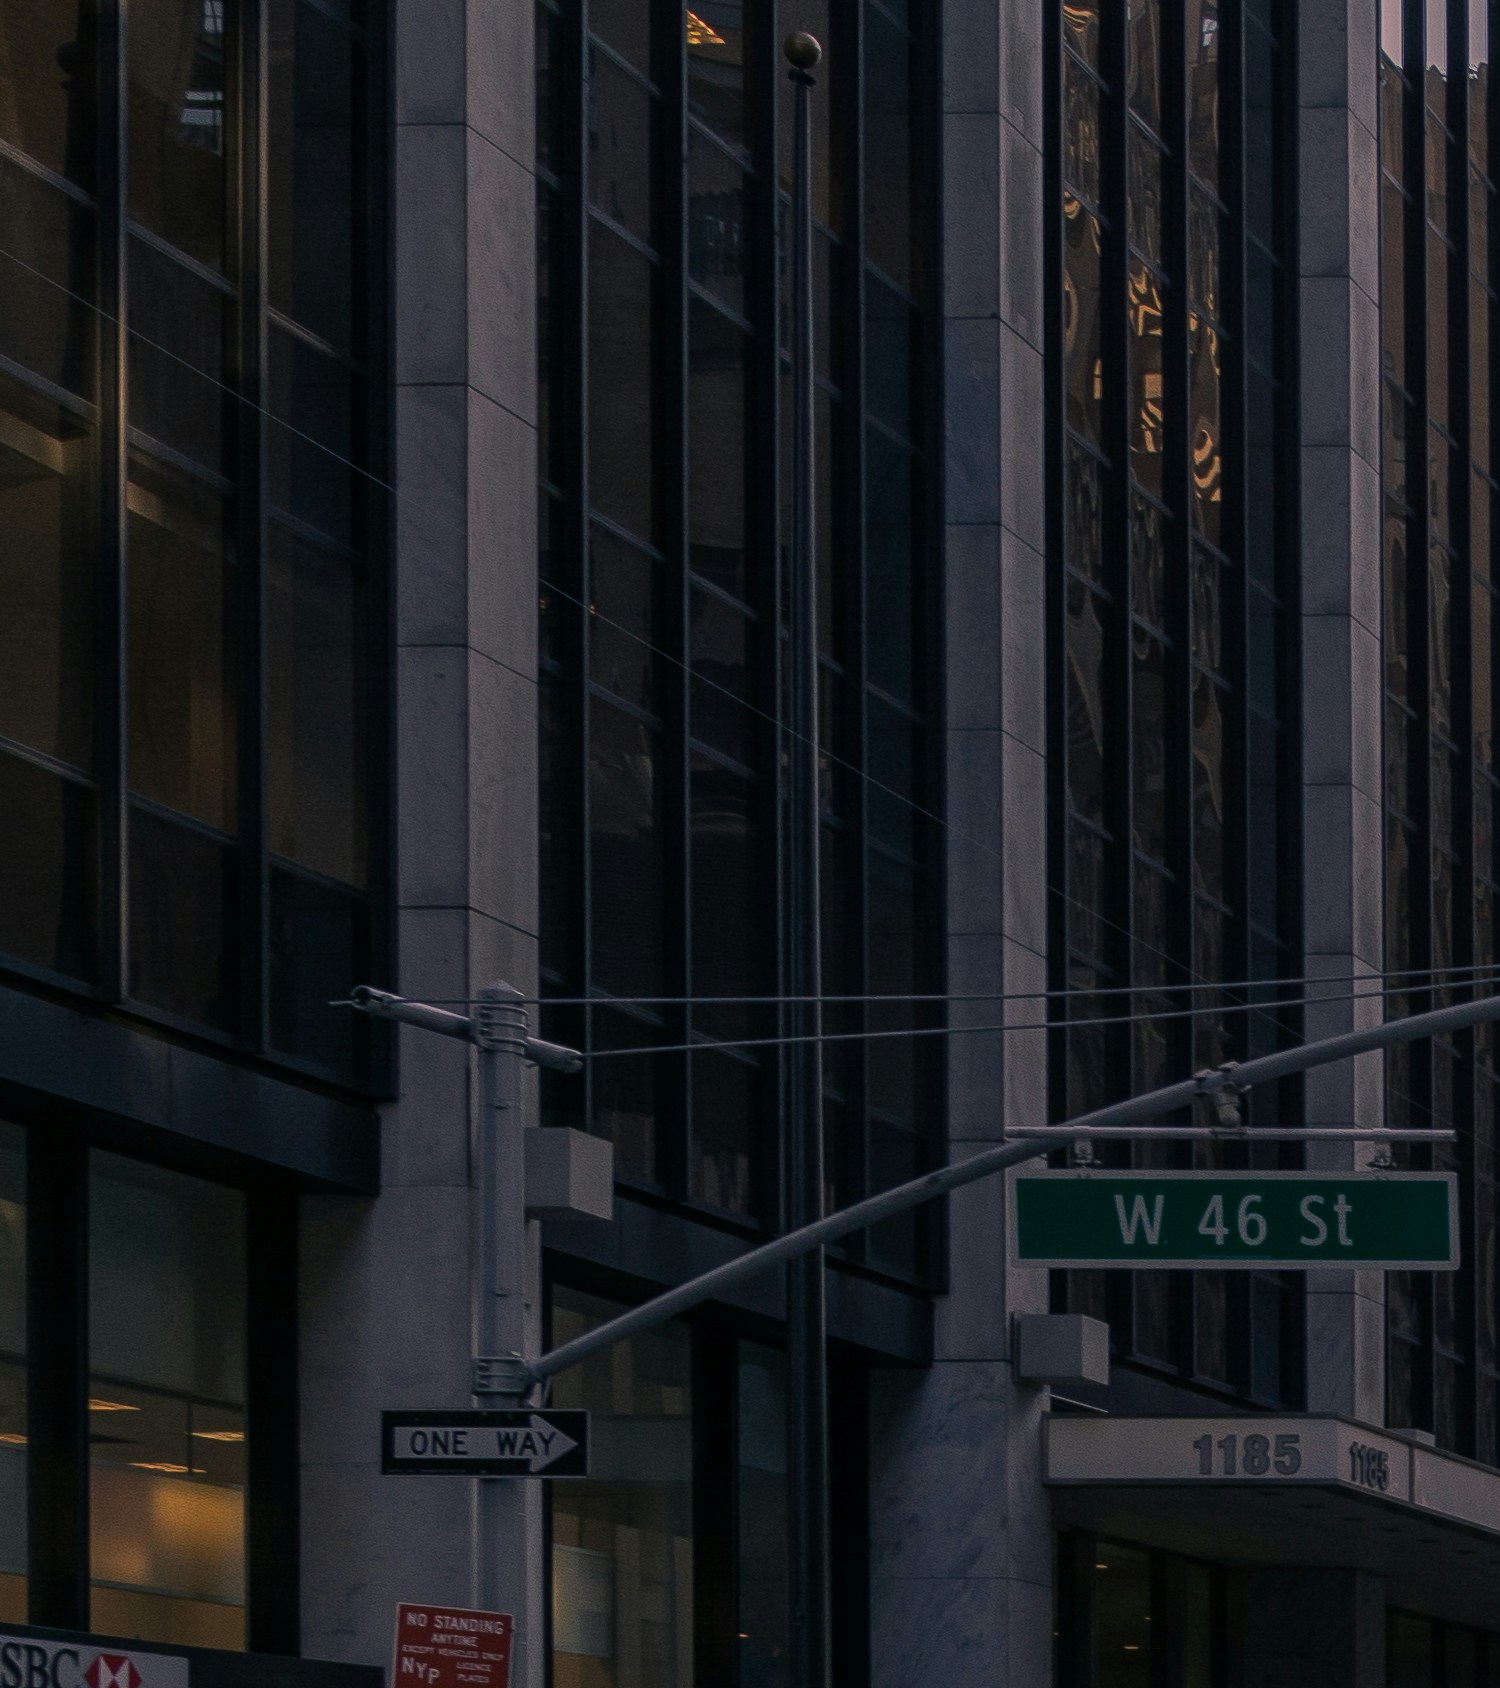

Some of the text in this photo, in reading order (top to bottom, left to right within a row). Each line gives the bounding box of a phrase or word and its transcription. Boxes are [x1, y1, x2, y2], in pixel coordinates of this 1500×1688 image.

[1113, 1194, 1354, 1247] W 46 St
[410, 1430, 556, 1456] ONE WAY
[1193, 1434, 1303, 1476] 1185
[1349, 1441, 1390, 1490] 1185
[406, 1612, 504, 1635] NO STANDING
[431, 1633, 479, 1647] ANYTIME
[402, 1657, 440, 1684] NYP
